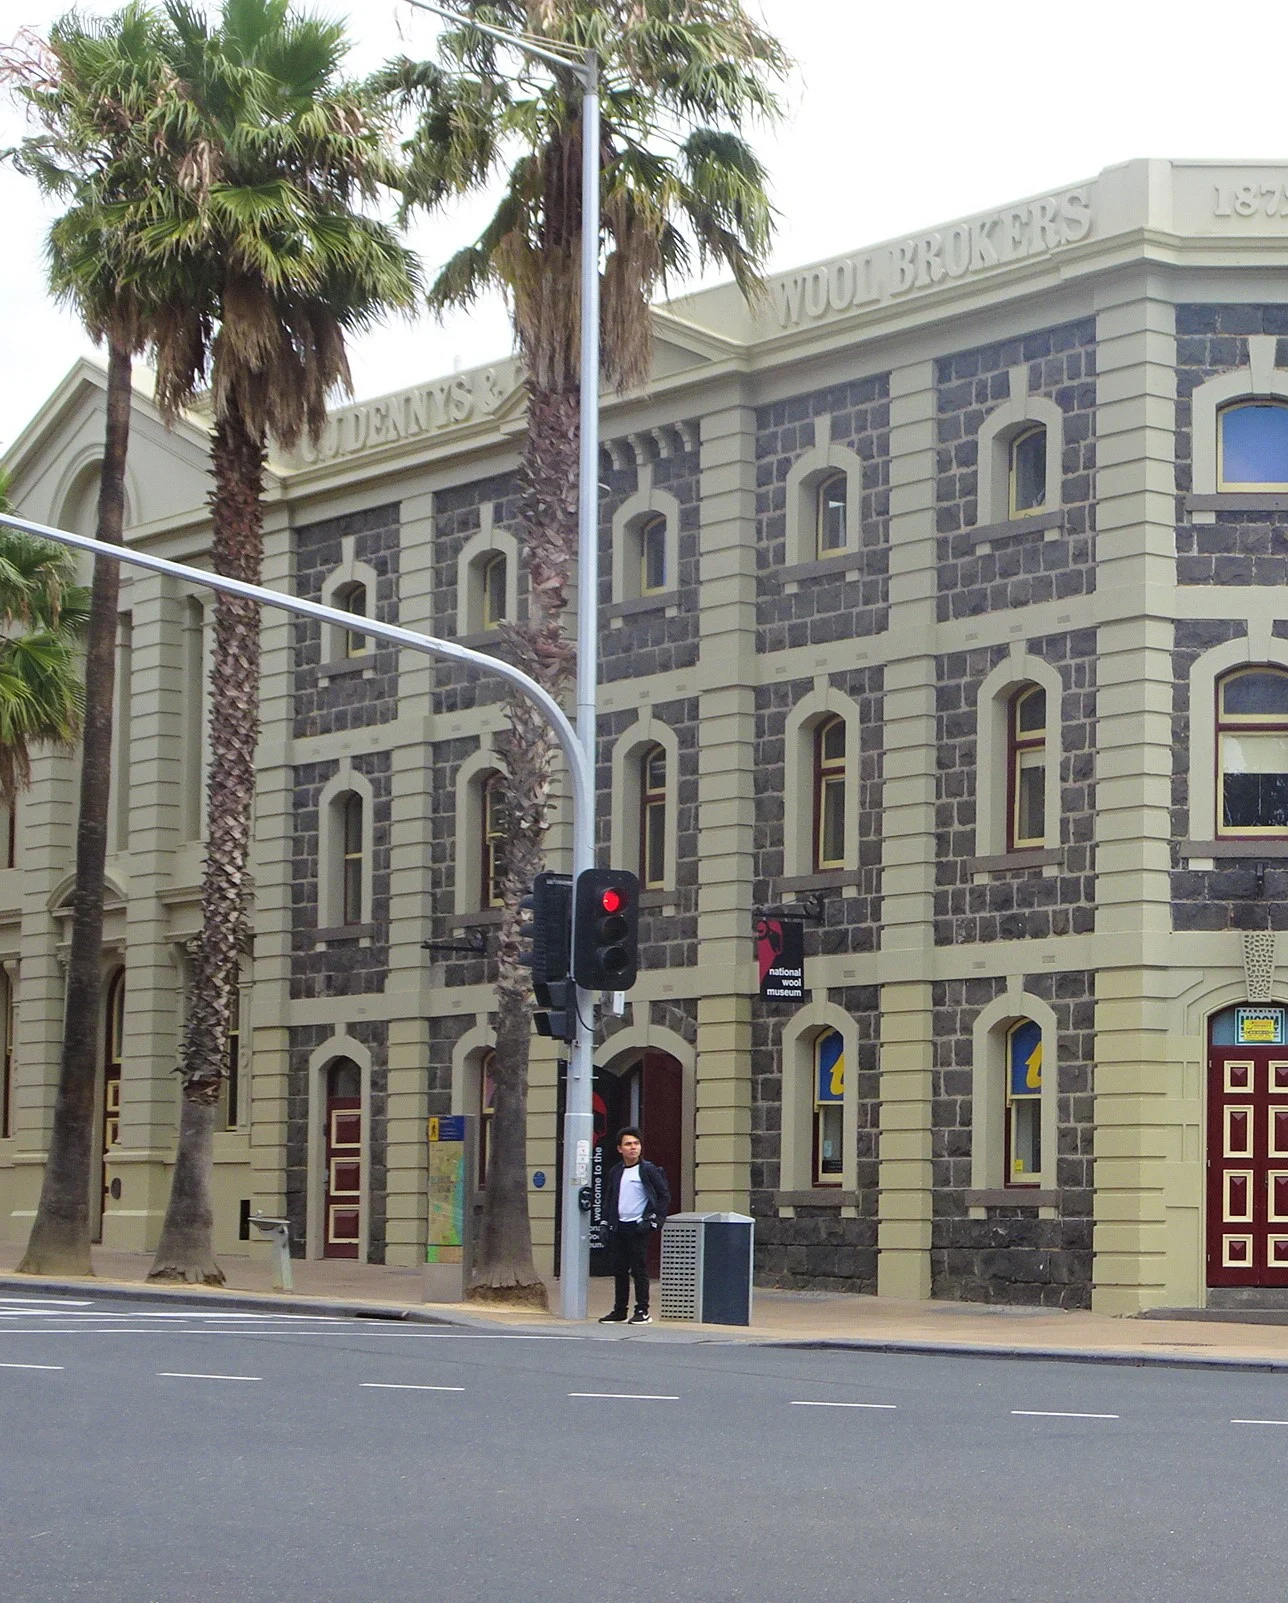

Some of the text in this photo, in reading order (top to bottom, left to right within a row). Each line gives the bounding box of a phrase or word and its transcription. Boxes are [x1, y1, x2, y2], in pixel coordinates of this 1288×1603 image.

[775, 194, 1094, 328] WOOL BROKERS
[769, 967, 801, 976] national
[781, 978, 802, 986] wool
[766, 988, 802, 997] museum
[593, 1146, 603, 1162] the
[593, 1165, 602, 1175] to
[593, 1177, 602, 1221] welcome
